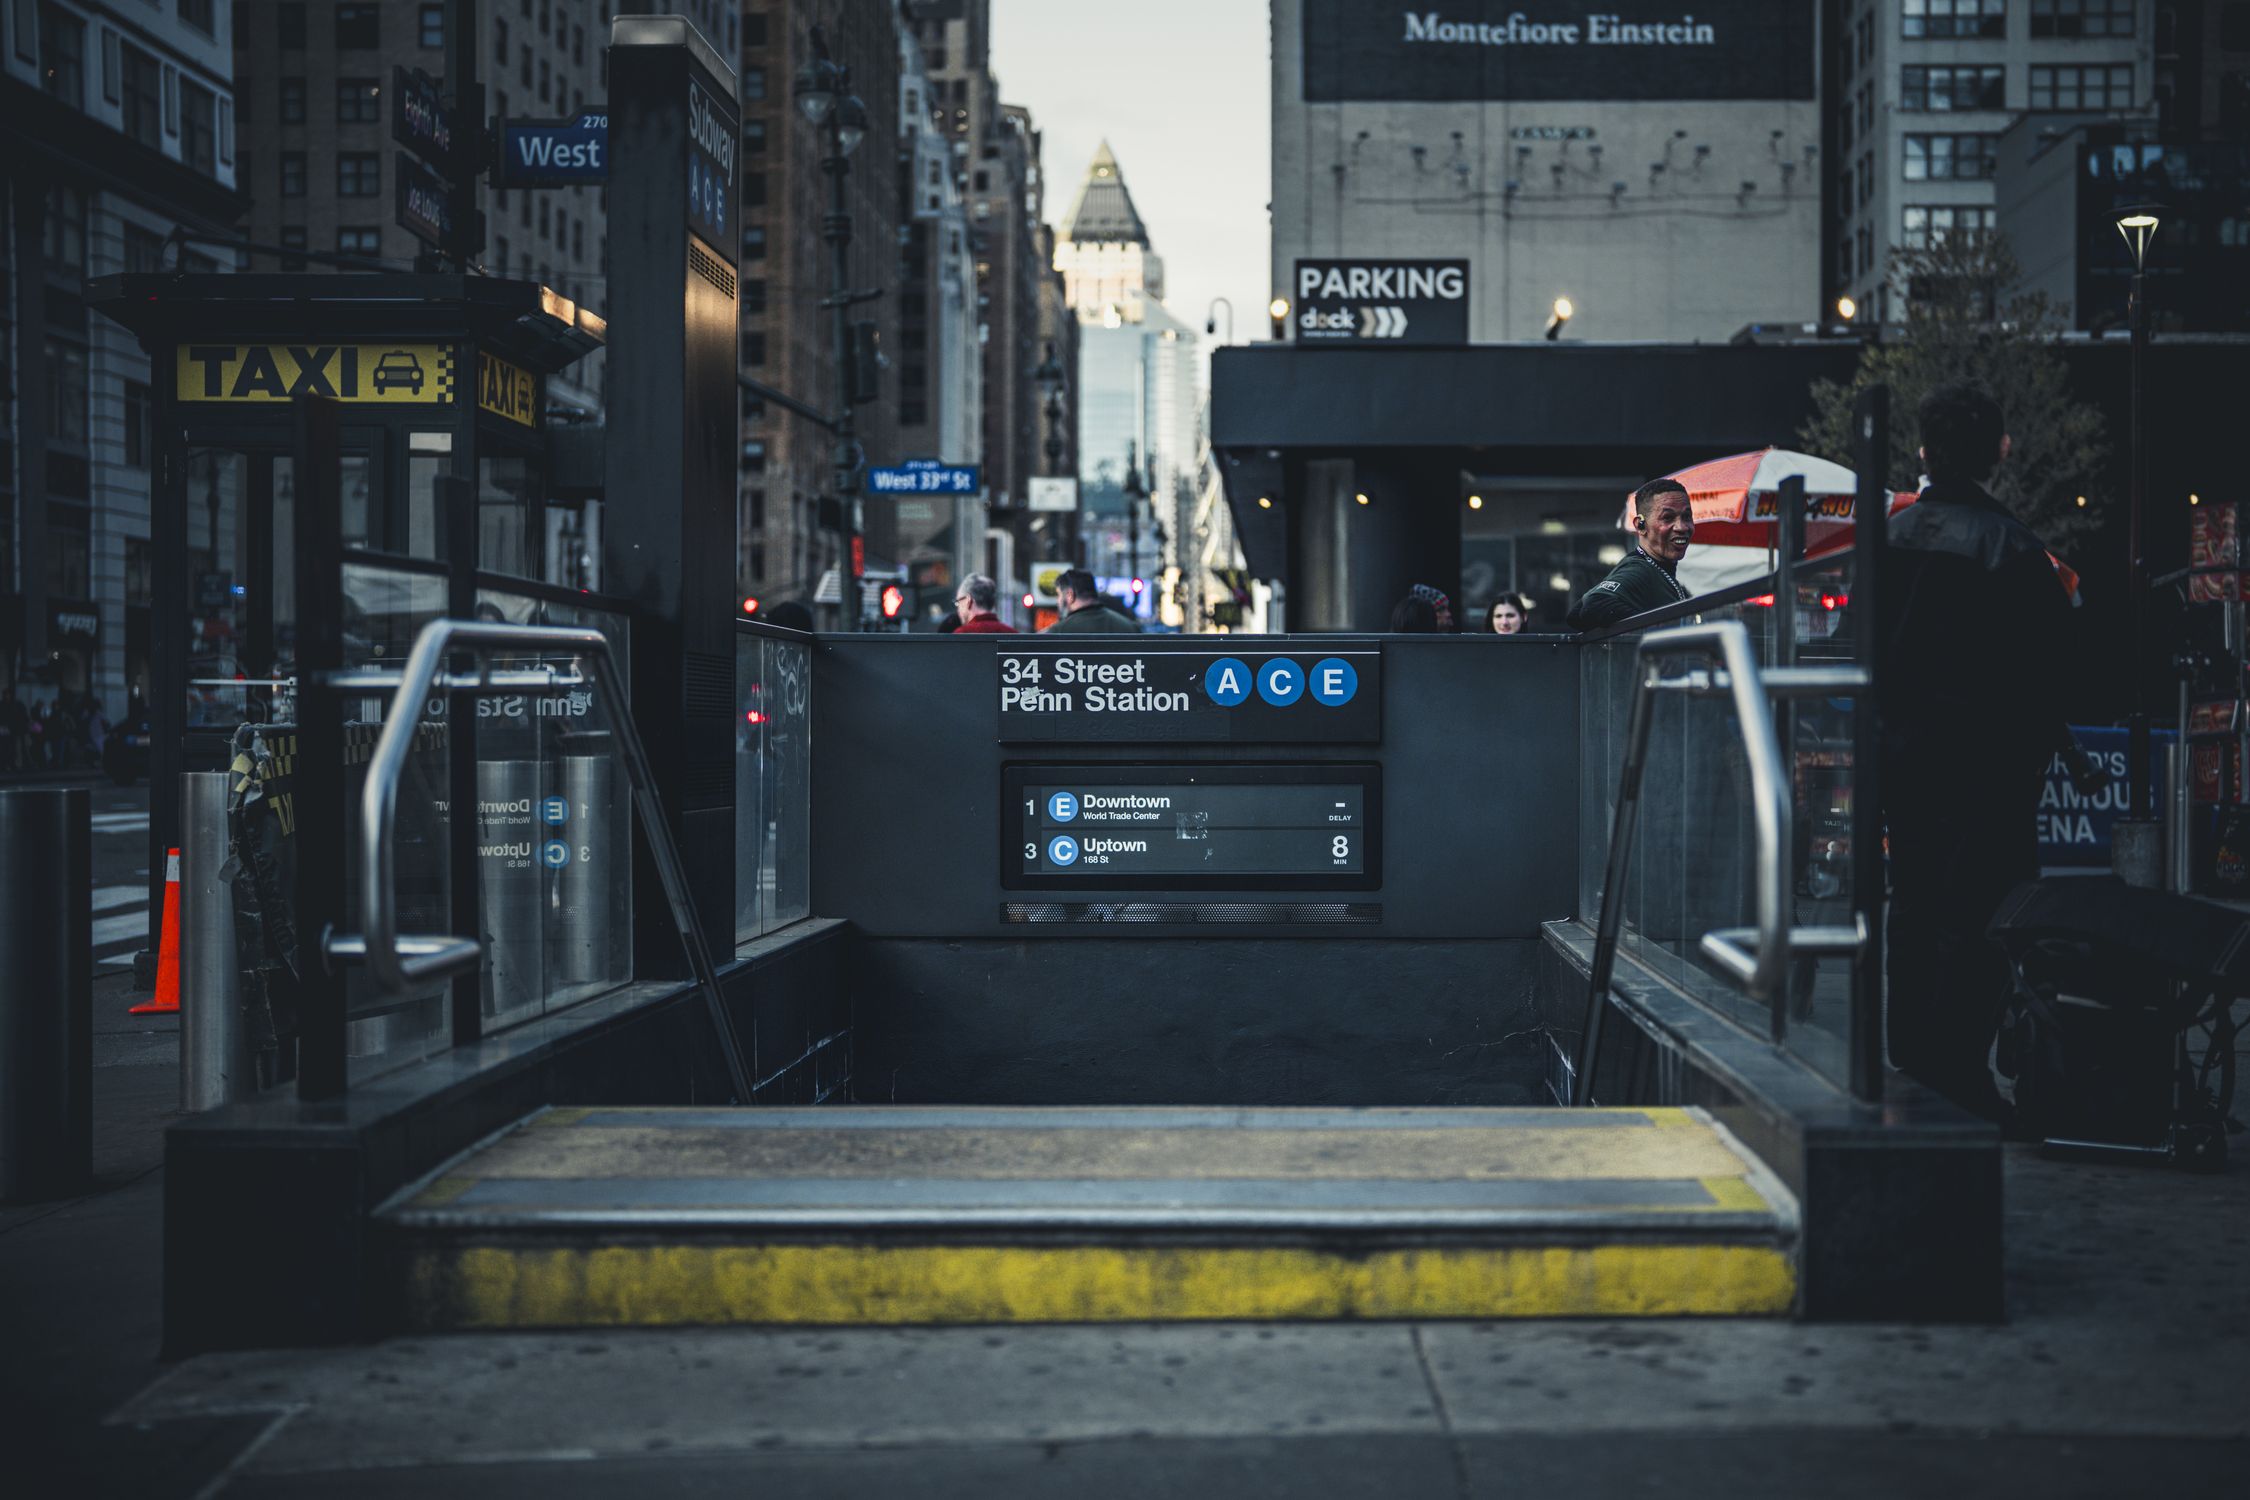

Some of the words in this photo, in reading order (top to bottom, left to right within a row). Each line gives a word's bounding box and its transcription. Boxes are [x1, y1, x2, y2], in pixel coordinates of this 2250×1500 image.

[1405, 12, 1579, 43] Montefiore
[1589, 16, 1715, 43] Einstein
[583, 115, 609, 129] 270
[689, 82, 735, 188] Subway
[518, 135, 601, 169] West
[1299, 267, 1464, 299] PARKING
[189, 346, 358, 397] TAXI
[478, 352, 516, 418] TAXI
[872, 470, 918, 491] West
[952, 470, 972, 491] St
[1002, 658, 1042, 683] 34
[1054, 658, 1145, 684] Street
[1217, 667, 1241, 694] A
[1269, 669, 1292, 696] C
[1323, 668, 1344, 695] E
[1001, 686, 1072, 712] Penn
[1085, 686, 1190, 712] Station
[1025, 799, 1035, 816] 1
[1056, 797, 1071, 817] E
[1083, 794, 1171, 809] Downtown
[1083, 811, 1107, 820] World
[1109, 811, 1132, 820] Trade
[1133, 811, 1160, 821] Center
[1024, 842, 1037, 860] 3
[1054, 840, 1073, 861] C
[1083, 837, 1147, 855] Uptown
[1332, 835, 1349, 858] 8
[1083, 855, 1098, 864] 168
[1099, 855, 1110, 864] St
